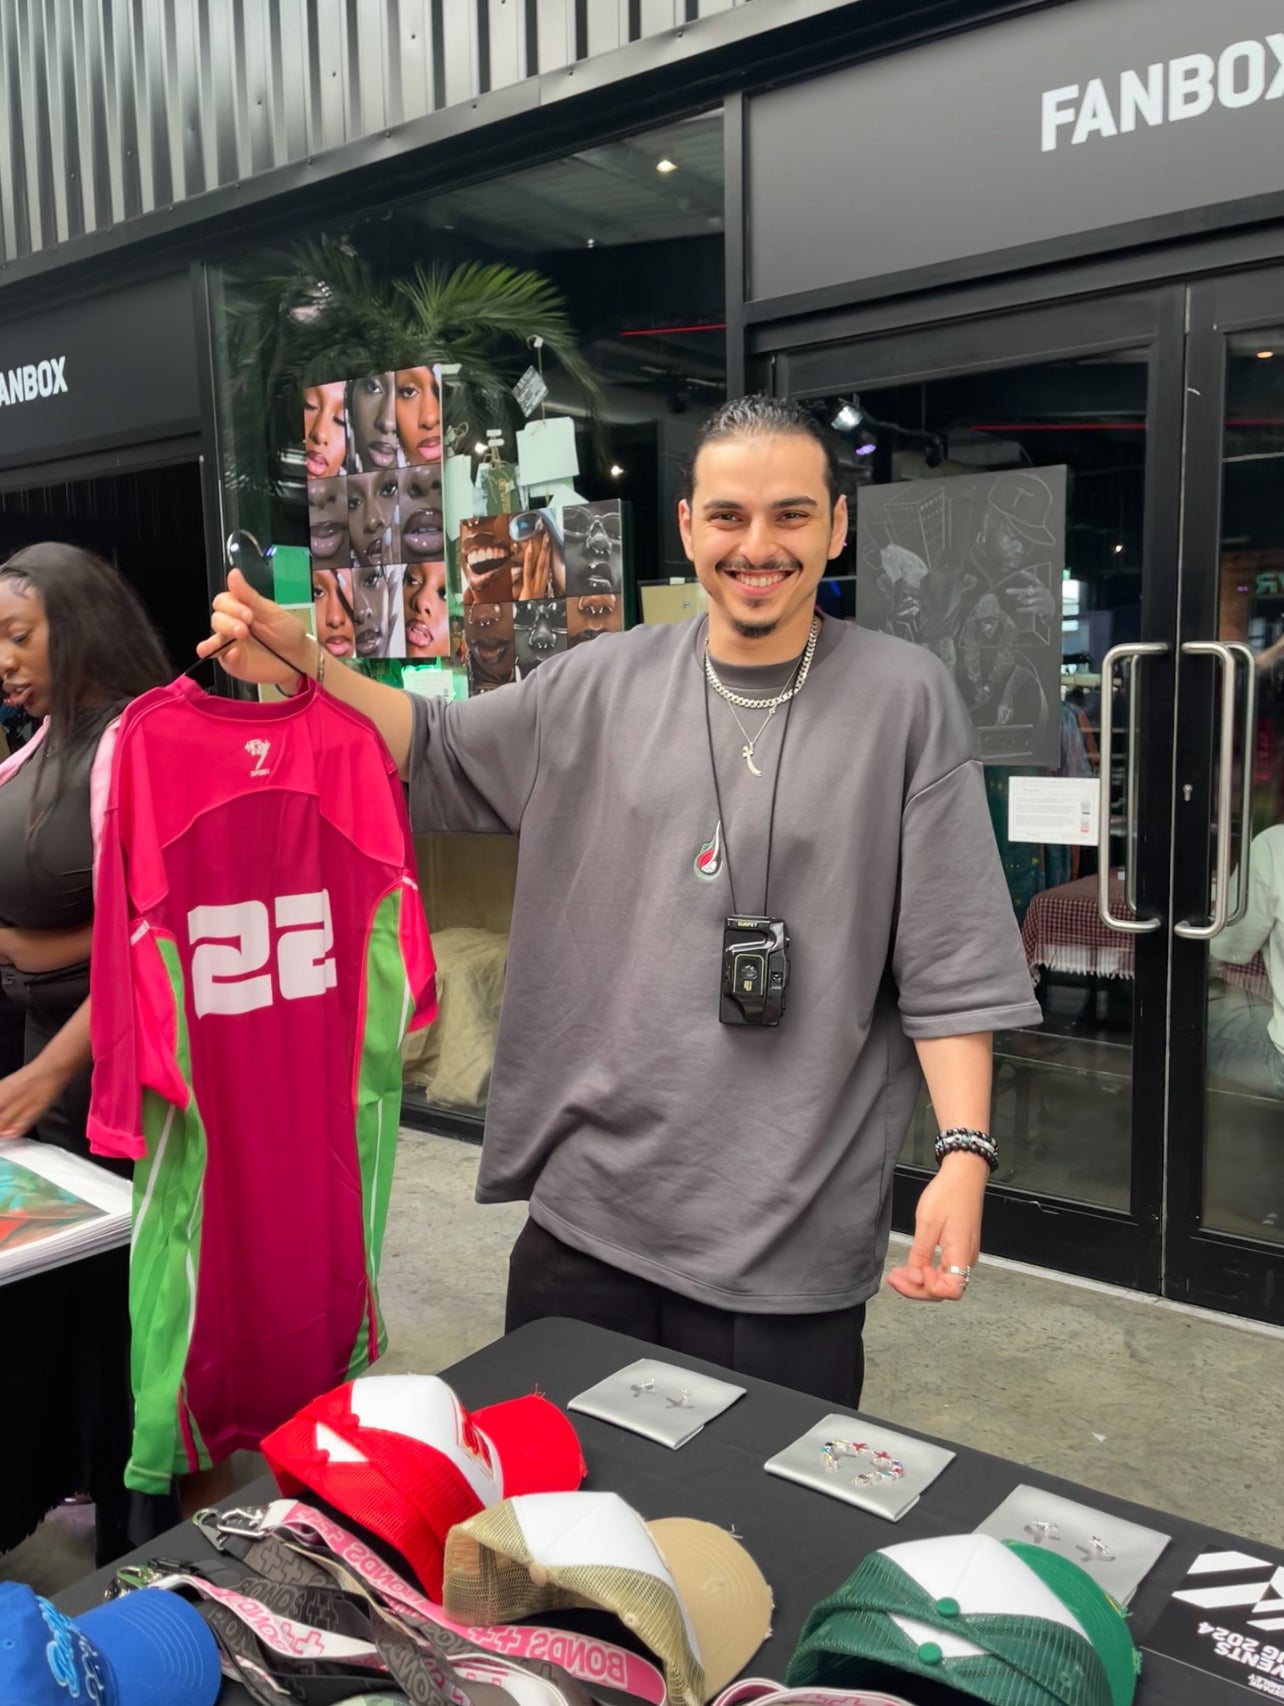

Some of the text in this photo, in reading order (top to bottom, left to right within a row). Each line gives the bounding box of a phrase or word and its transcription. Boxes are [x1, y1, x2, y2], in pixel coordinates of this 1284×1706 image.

[0, 355, 68, 407] ANBOX
[187, 888, 338, 1021] 22
[1197, 1621, 1260, 1653] 2024
